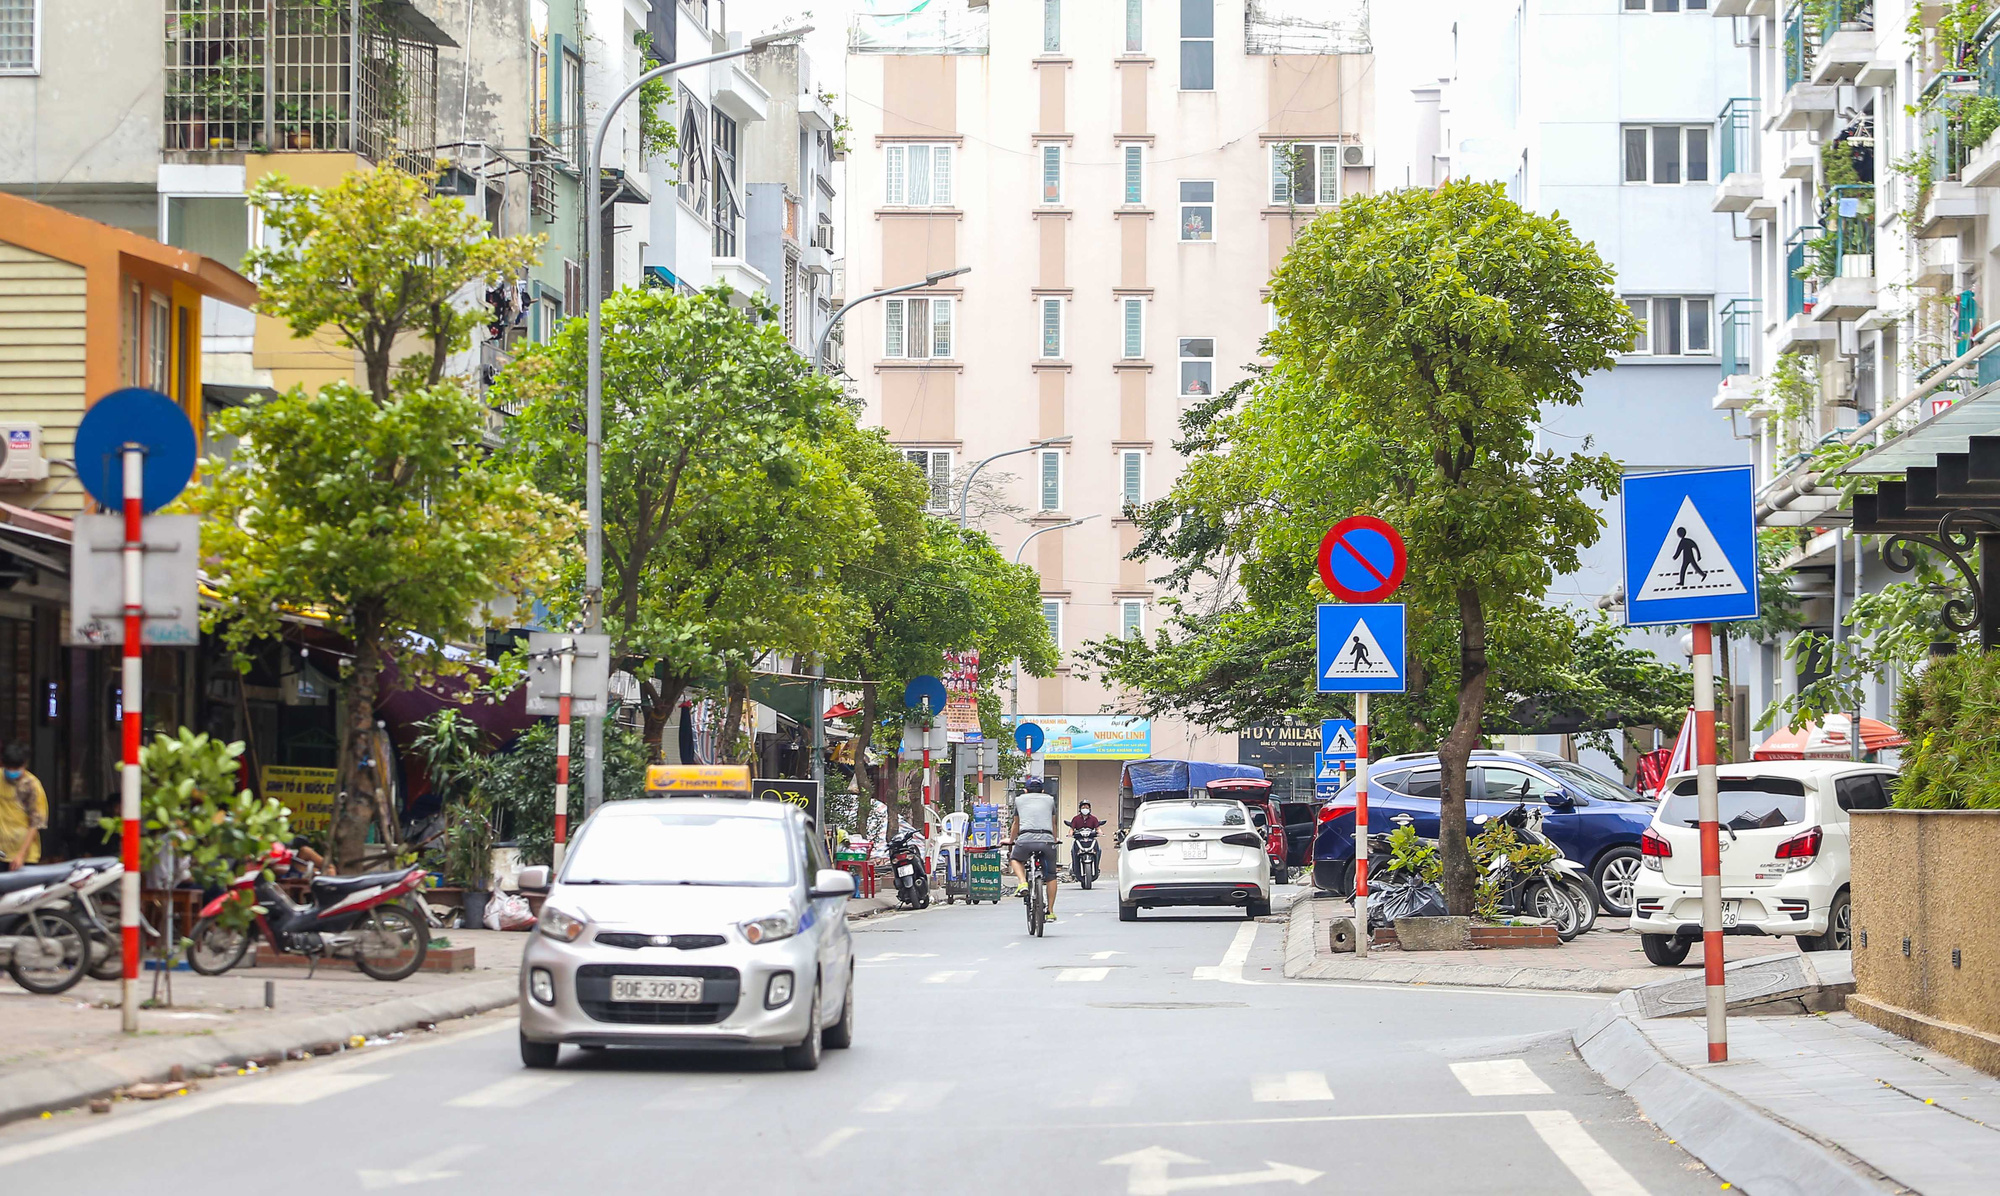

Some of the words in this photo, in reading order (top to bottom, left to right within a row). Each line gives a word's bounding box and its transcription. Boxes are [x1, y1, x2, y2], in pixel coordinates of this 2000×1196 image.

[1094, 731, 1124, 740] NHUNG
[1126, 731, 1146, 740] LINH
[1240, 727, 1275, 740] HUY
